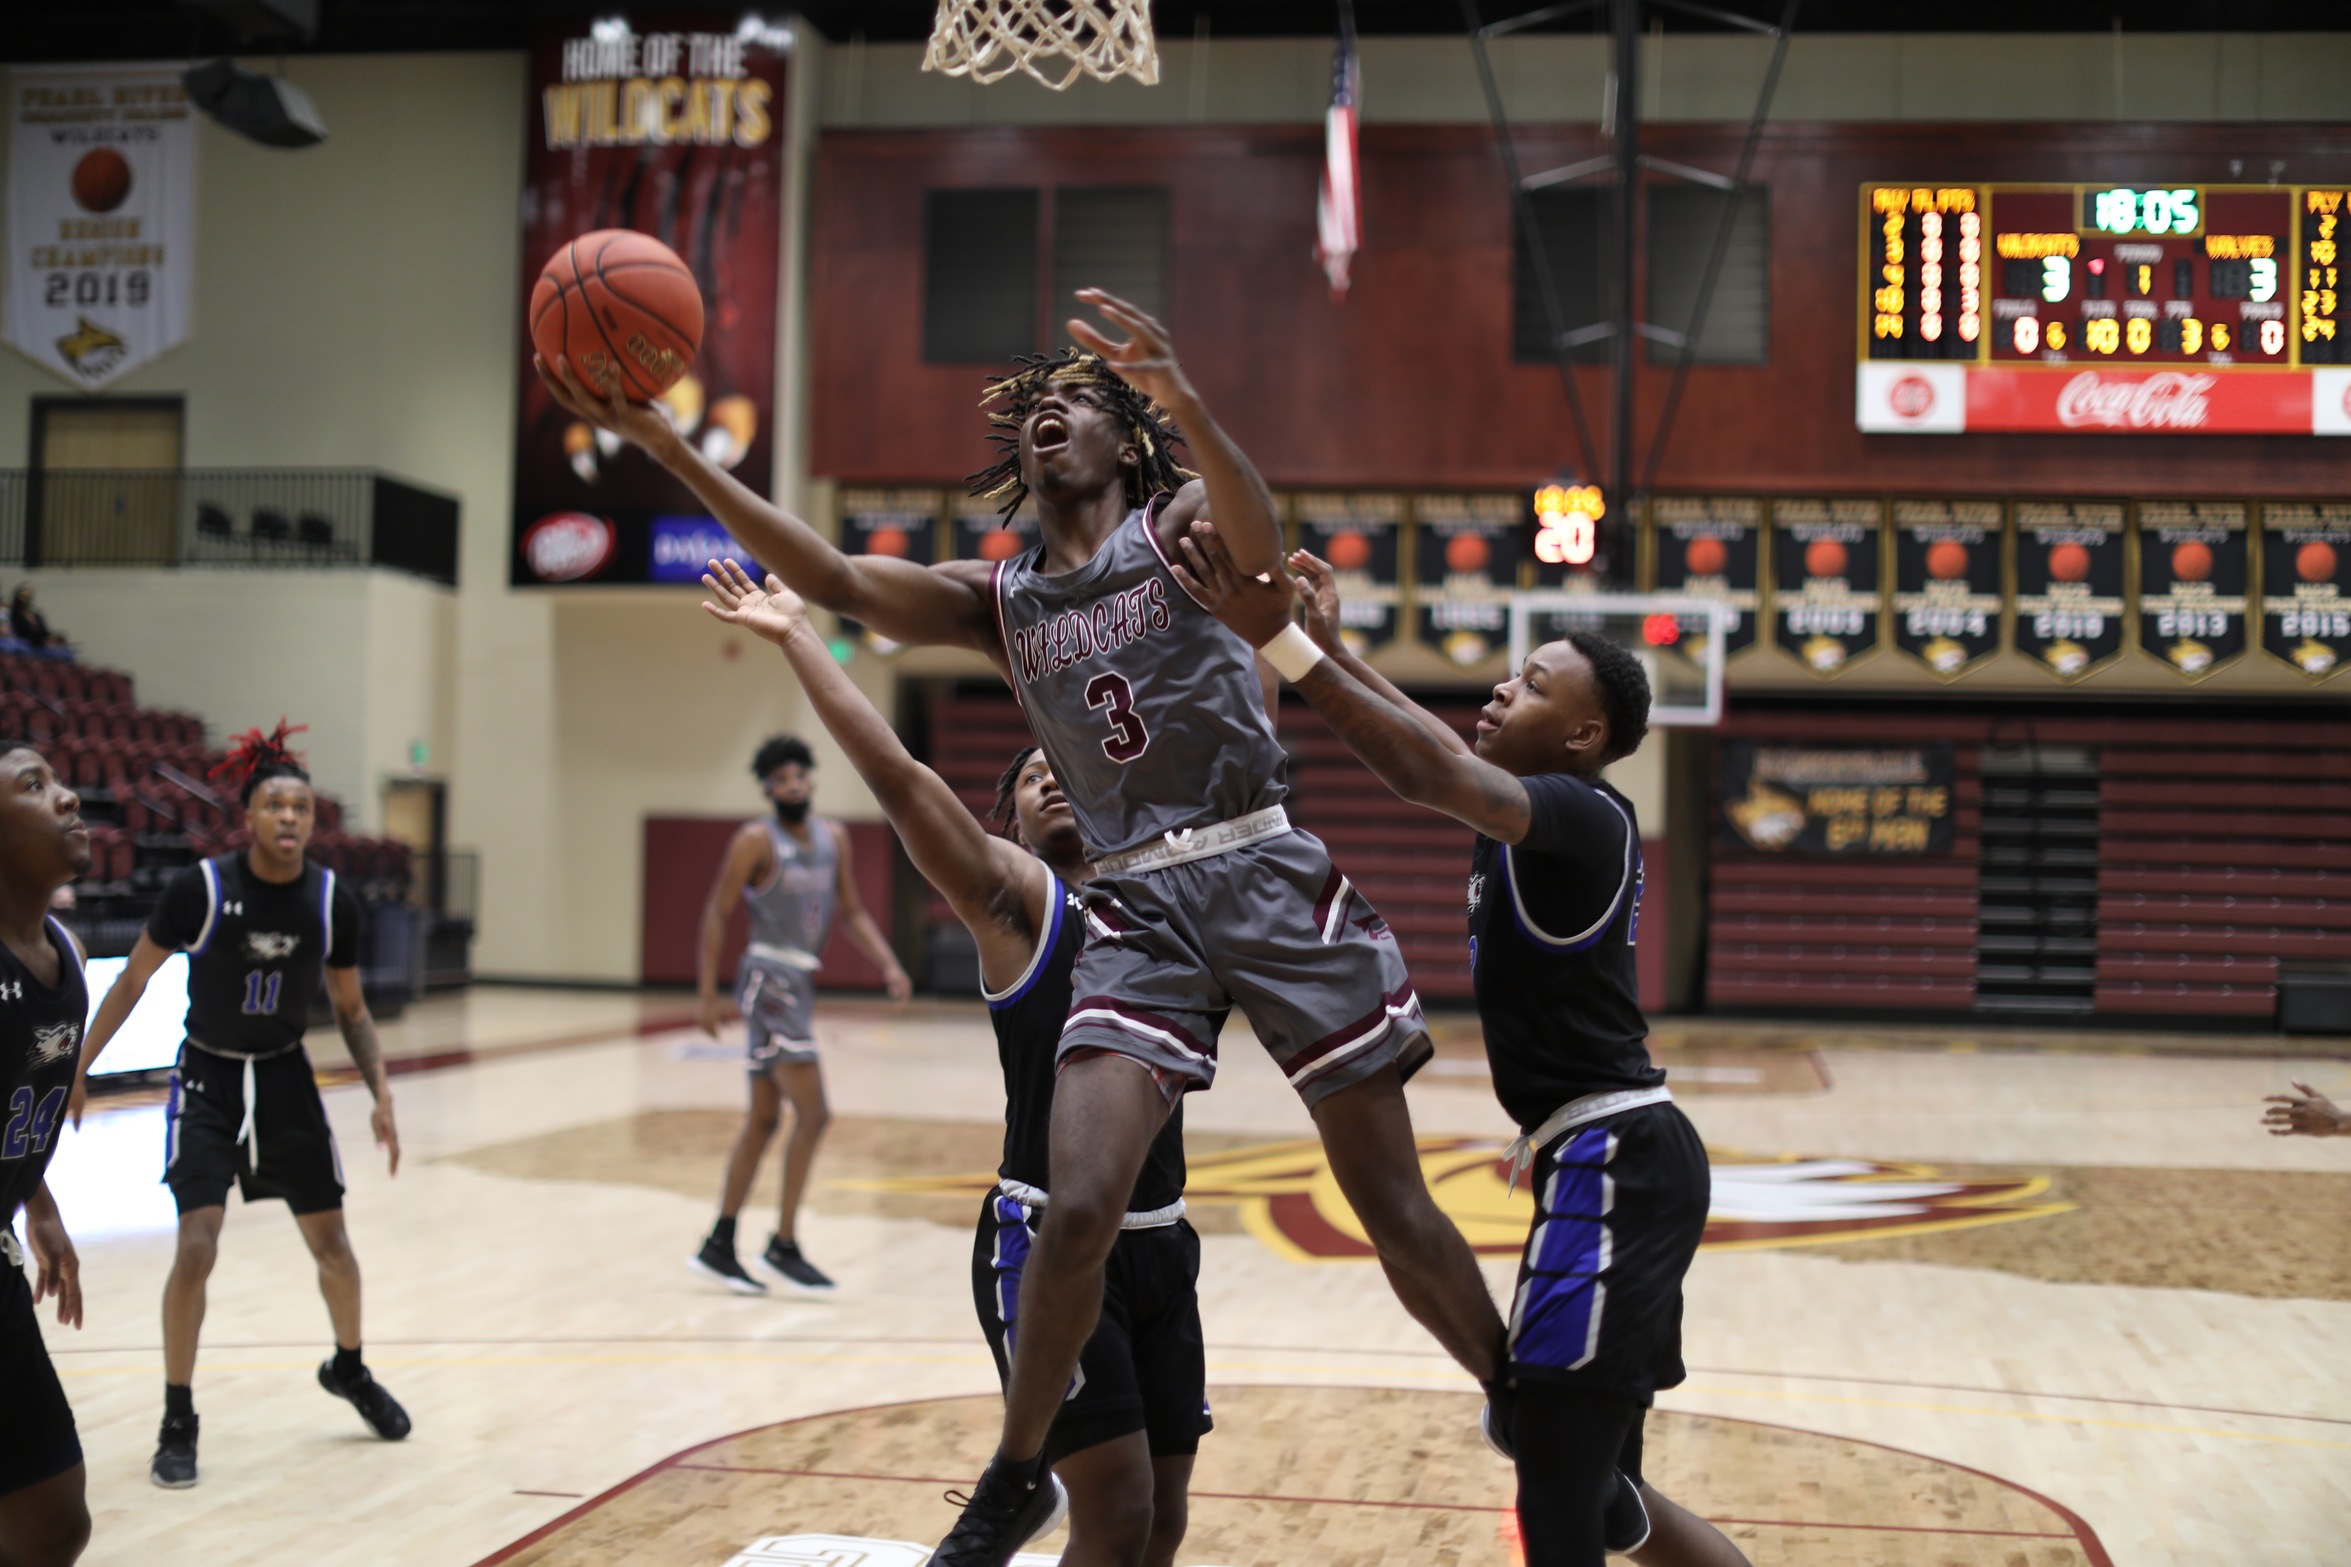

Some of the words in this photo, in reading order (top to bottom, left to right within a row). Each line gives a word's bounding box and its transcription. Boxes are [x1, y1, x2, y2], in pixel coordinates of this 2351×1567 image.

[562, 37, 641, 80] HOME
[643, 33, 684, 77] OF
[687, 32, 749, 77] THE
[543, 76, 772, 151] WILDCATS
[2096, 188, 2199, 235] 18:05
[45, 270, 151, 308] 2019
[2042, 255, 2071, 303] 3
[2249, 257, 2277, 304] 3
[2013, 316, 2040, 355] 0
[2126, 317, 2152, 355] 0
[2181, 318, 2203, 356] 3
[2260, 320, 2285, 355] 0
[1534, 511, 1595, 565] 20
[1014, 577, 1170, 684] WILDCATS
[1084, 670, 1150, 764] 3
[1807, 786, 1869, 818] HOME
[242, 968, 283, 1015] 11
[0, 1085, 68, 1160] 24
